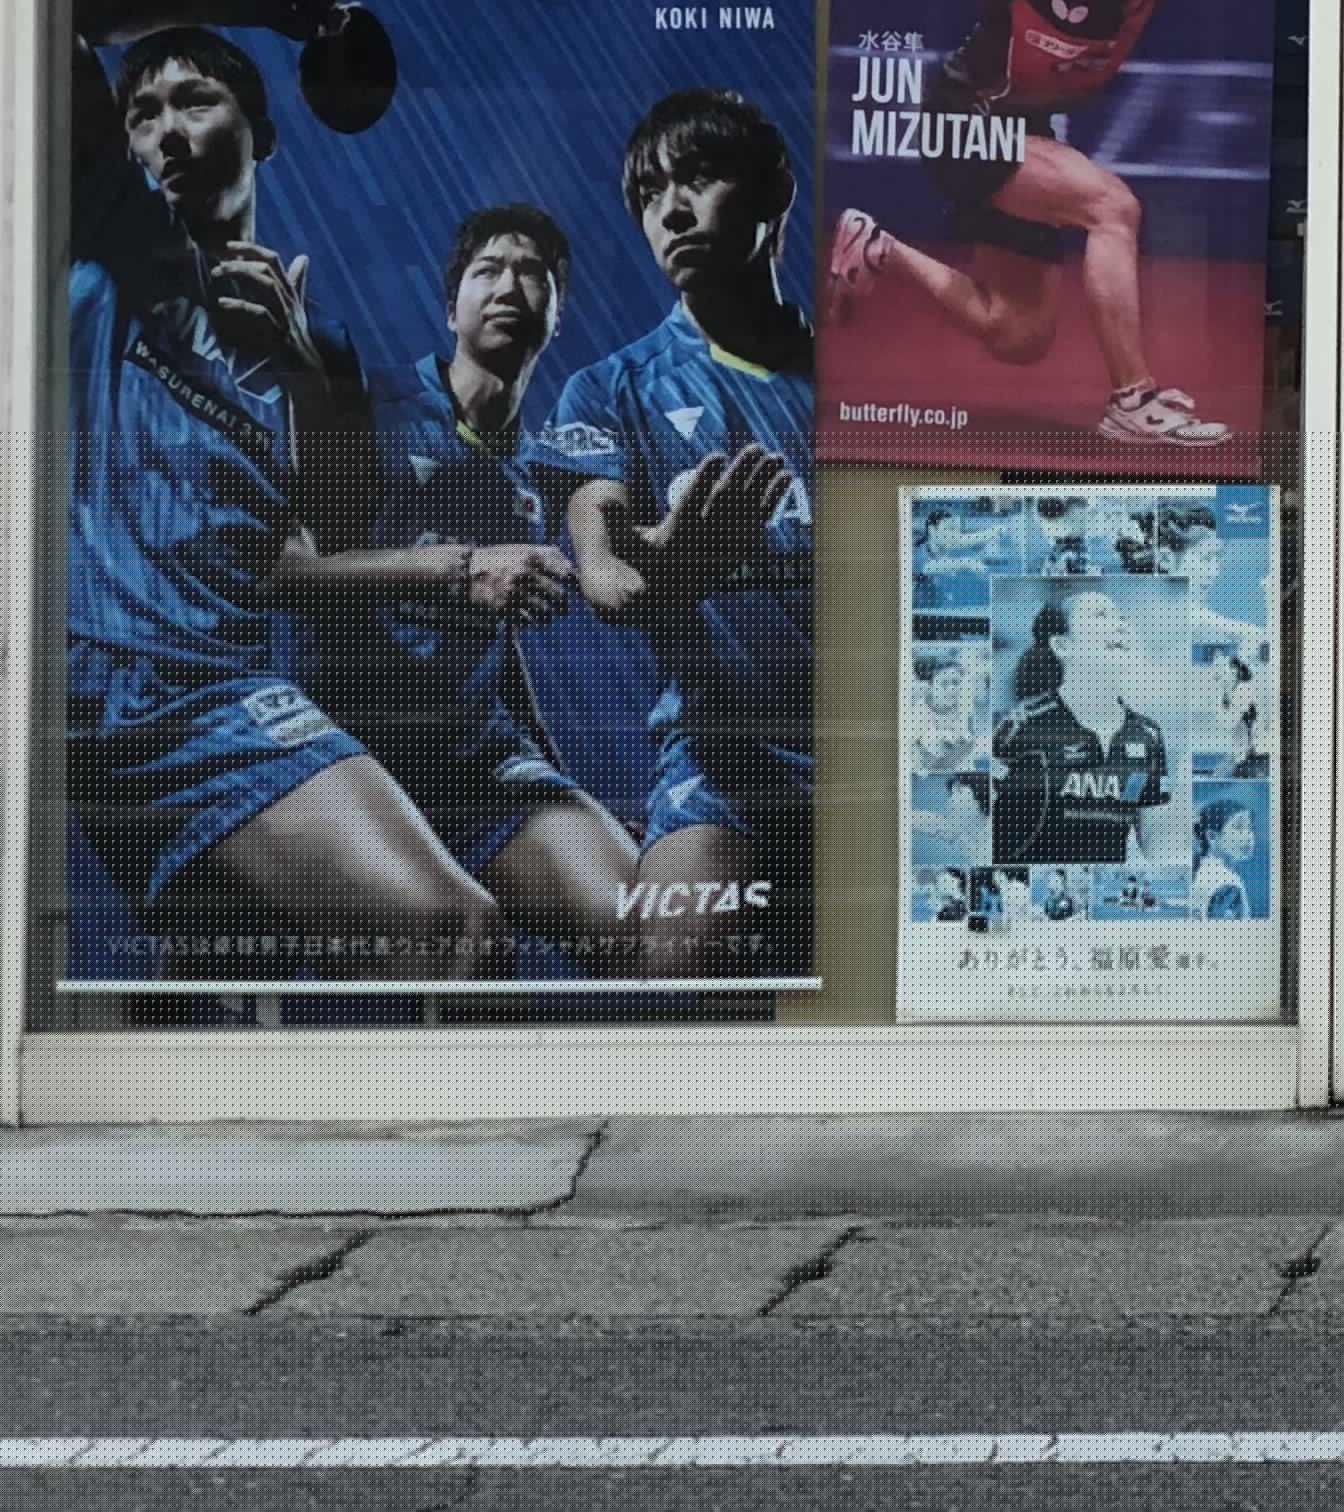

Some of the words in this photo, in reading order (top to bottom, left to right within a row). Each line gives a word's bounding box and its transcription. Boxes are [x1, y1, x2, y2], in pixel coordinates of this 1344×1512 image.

[655, 7, 710, 31] KOKI
[720, 7, 775, 30] NIWA
[859, 31, 924, 52] 水谷隼
[852, 58, 921, 105] JUN
[852, 110, 1026, 163] MIZUTANI
[136, 341, 237, 428] WASURENAI
[840, 401, 968, 430] butterfly.co.jp
[1059, 772, 1120, 800] ANA
[615, 881, 773, 920] VICTAS
